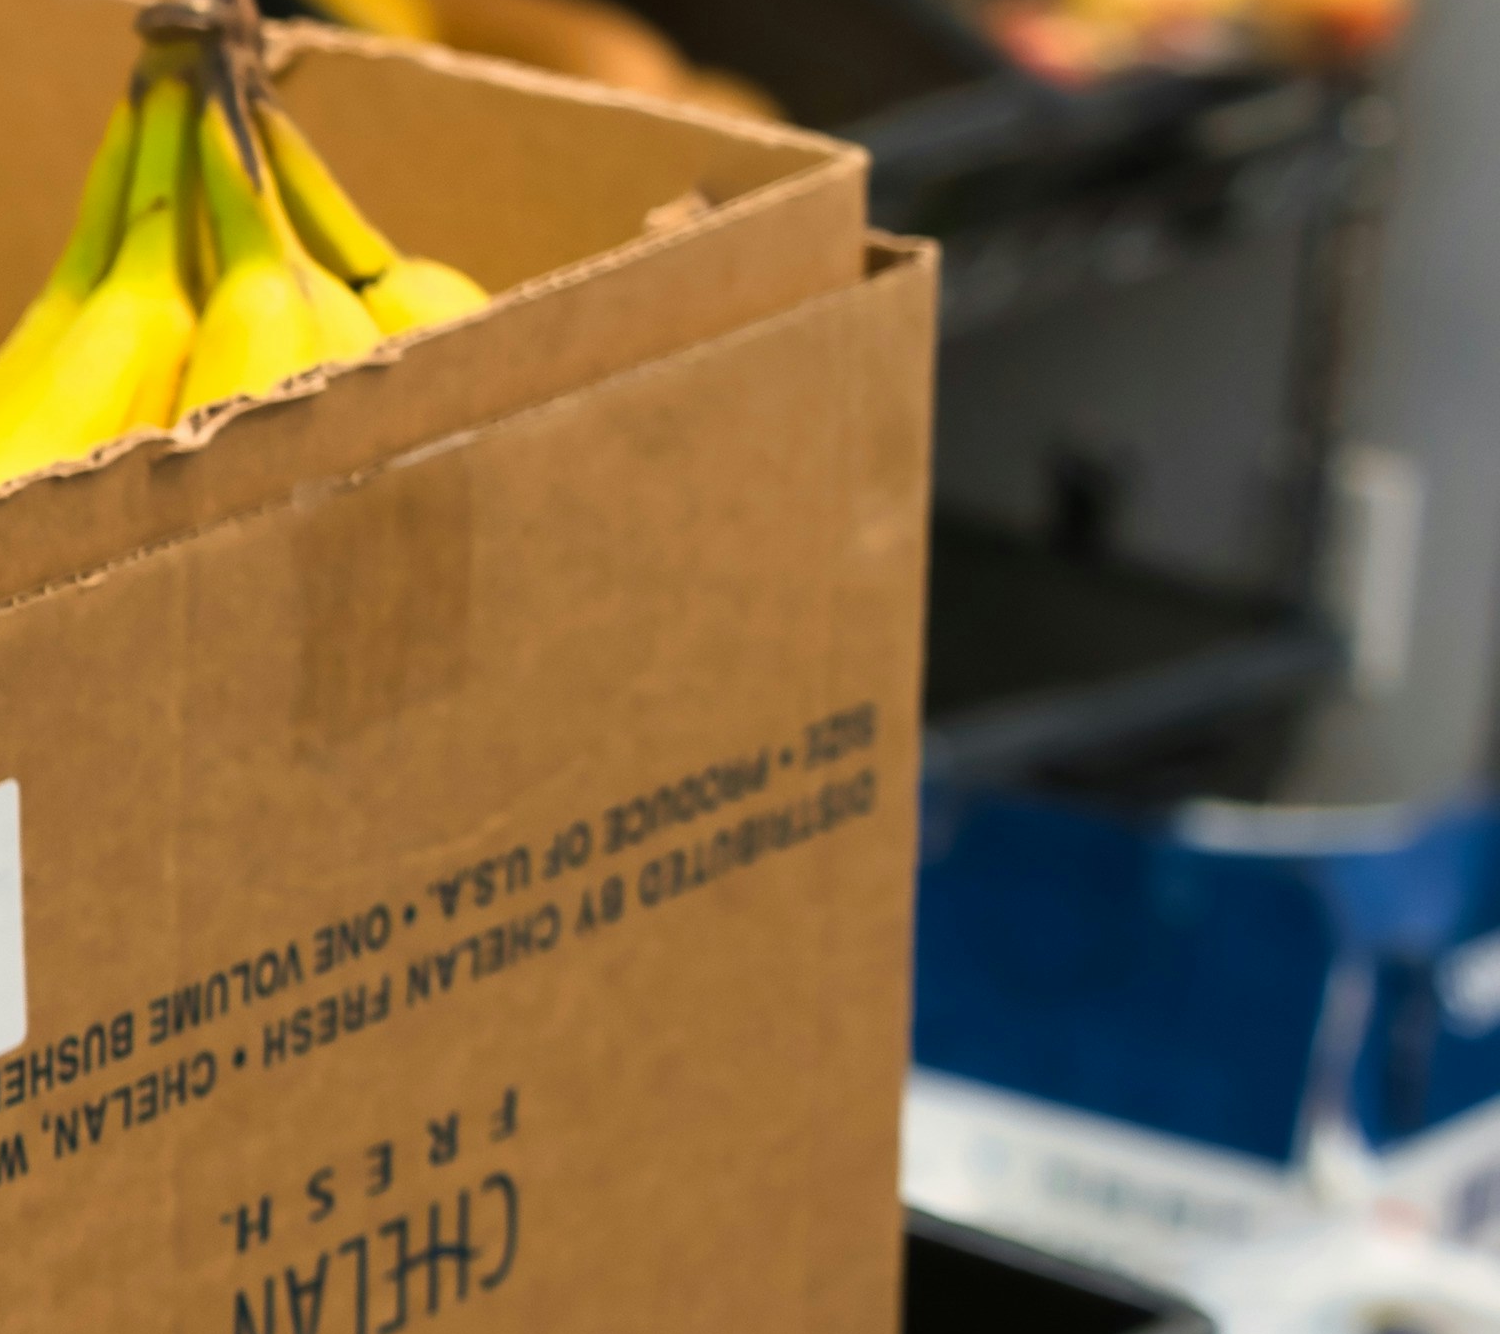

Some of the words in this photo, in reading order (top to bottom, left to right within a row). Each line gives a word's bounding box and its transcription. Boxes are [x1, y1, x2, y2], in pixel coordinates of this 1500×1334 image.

[542, 819, 595, 882] OF
[311, 903, 394, 975] ONE
[574, 873, 627, 938] BY
[147, 939, 304, 1047] VOLUME
[404, 902, 563, 1009] CHELAN
[261, 971, 393, 1069] FRESH
[40, 1048, 218, 1160] CHELAN,
